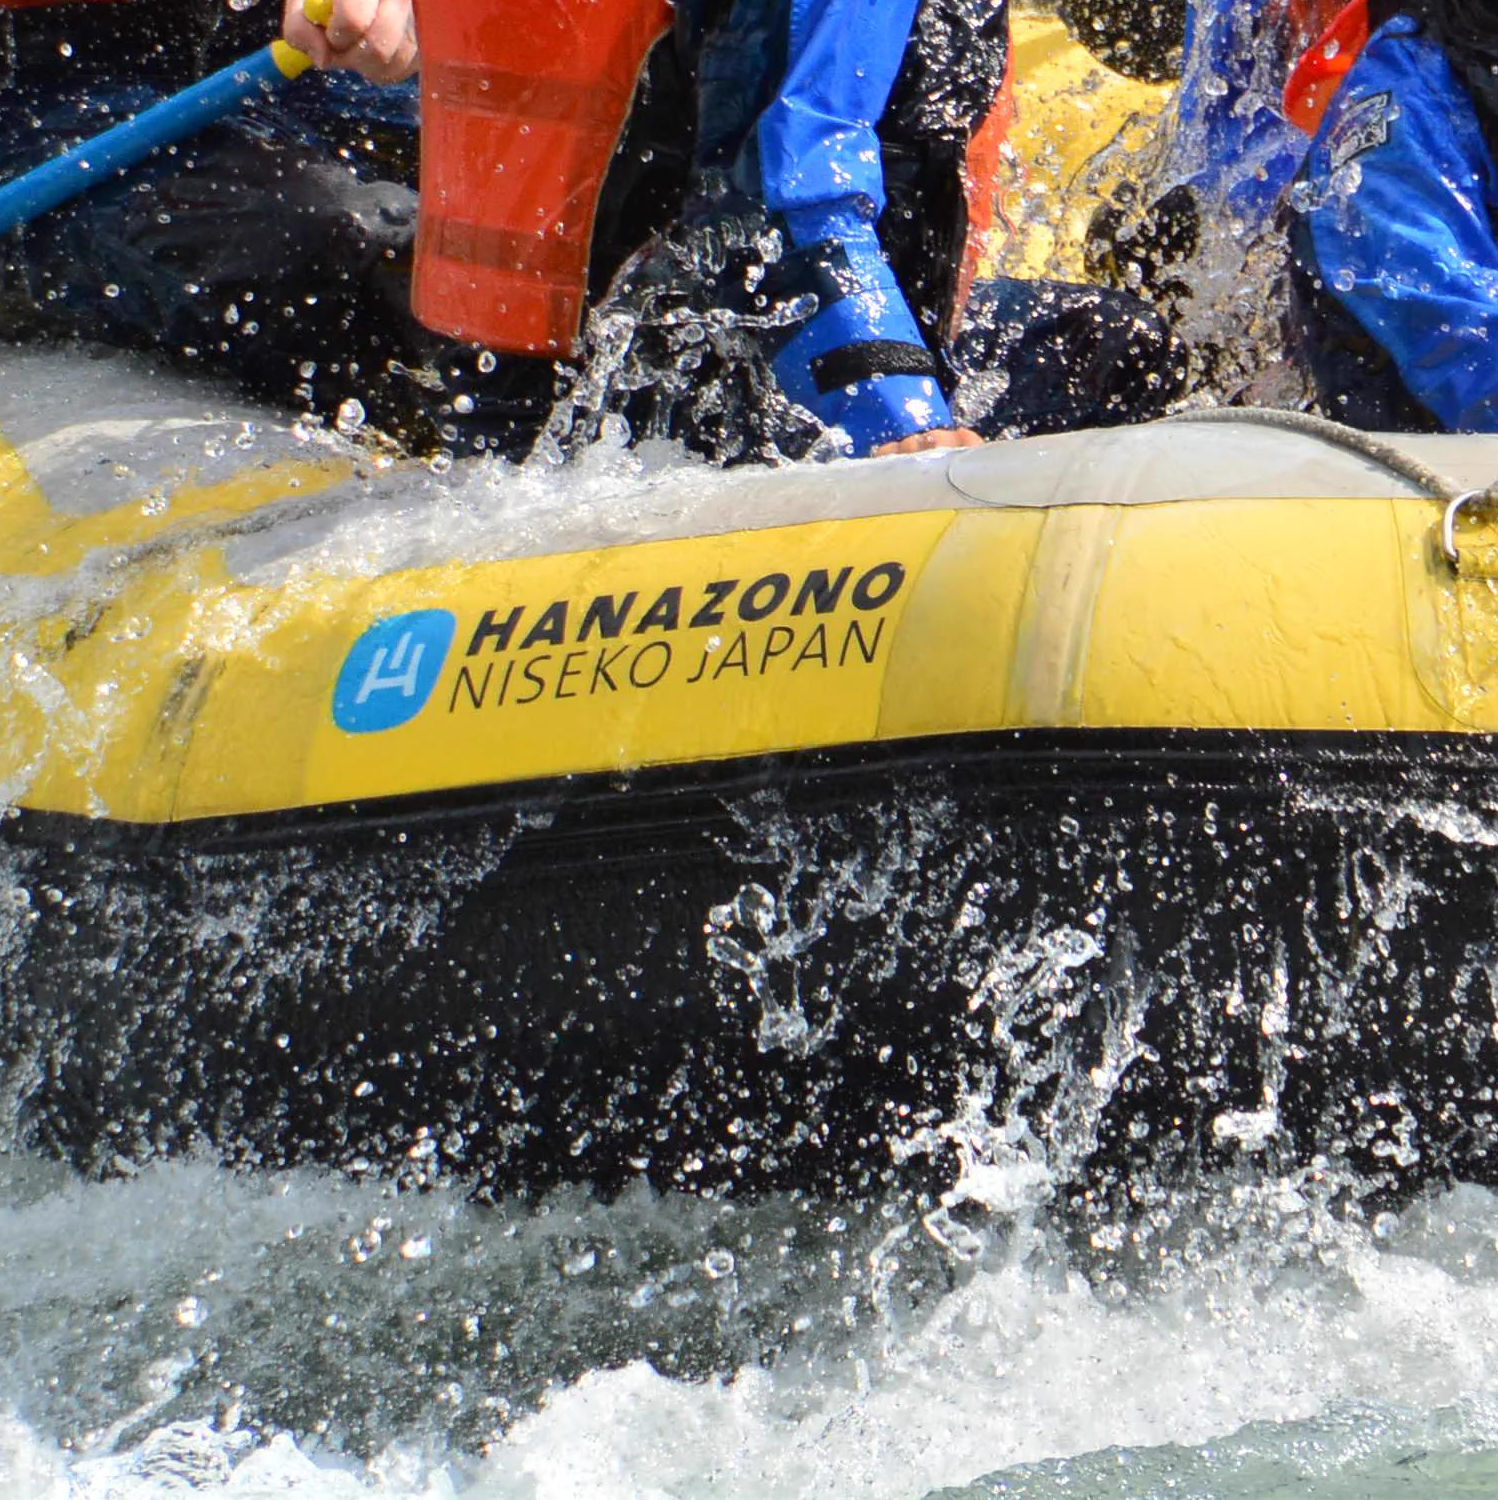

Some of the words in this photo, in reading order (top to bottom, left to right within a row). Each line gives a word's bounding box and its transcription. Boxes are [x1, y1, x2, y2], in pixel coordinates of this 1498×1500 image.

[465, 561, 905, 657] HANAZONO
[448, 639, 671, 714] NISEKO
[686, 617, 886, 684] JAPAN
